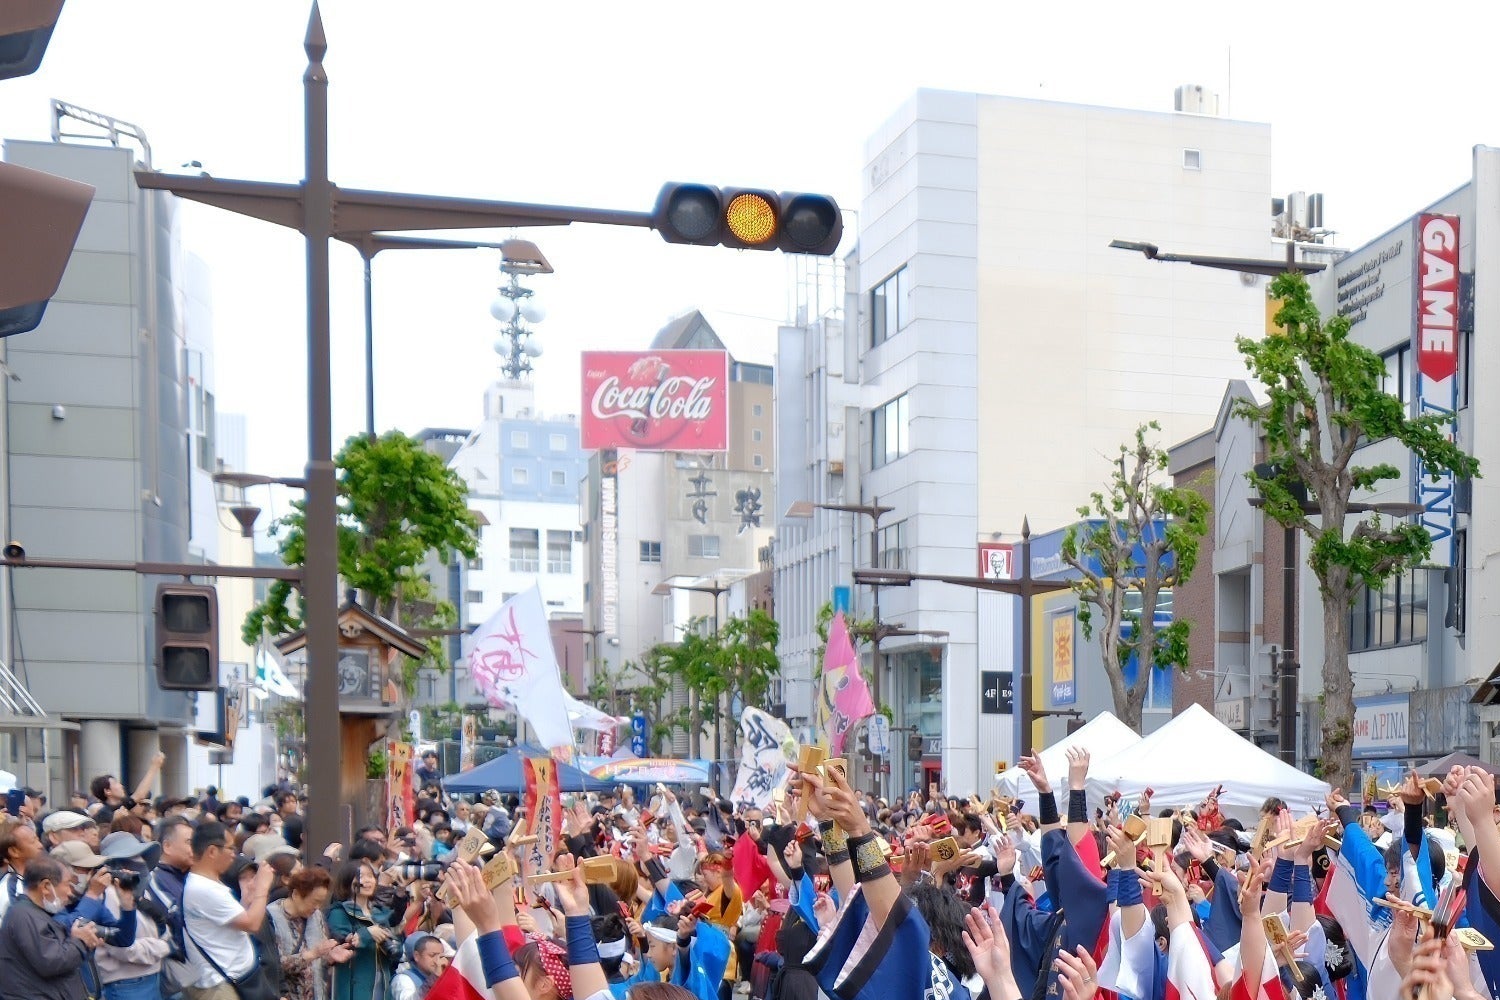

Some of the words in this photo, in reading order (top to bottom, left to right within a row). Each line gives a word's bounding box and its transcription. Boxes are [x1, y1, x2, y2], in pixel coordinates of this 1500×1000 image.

[1422, 219, 1455, 353] GAME
[985, 687, 996, 698] 4F
[1353, 720, 1369, 738] AME
